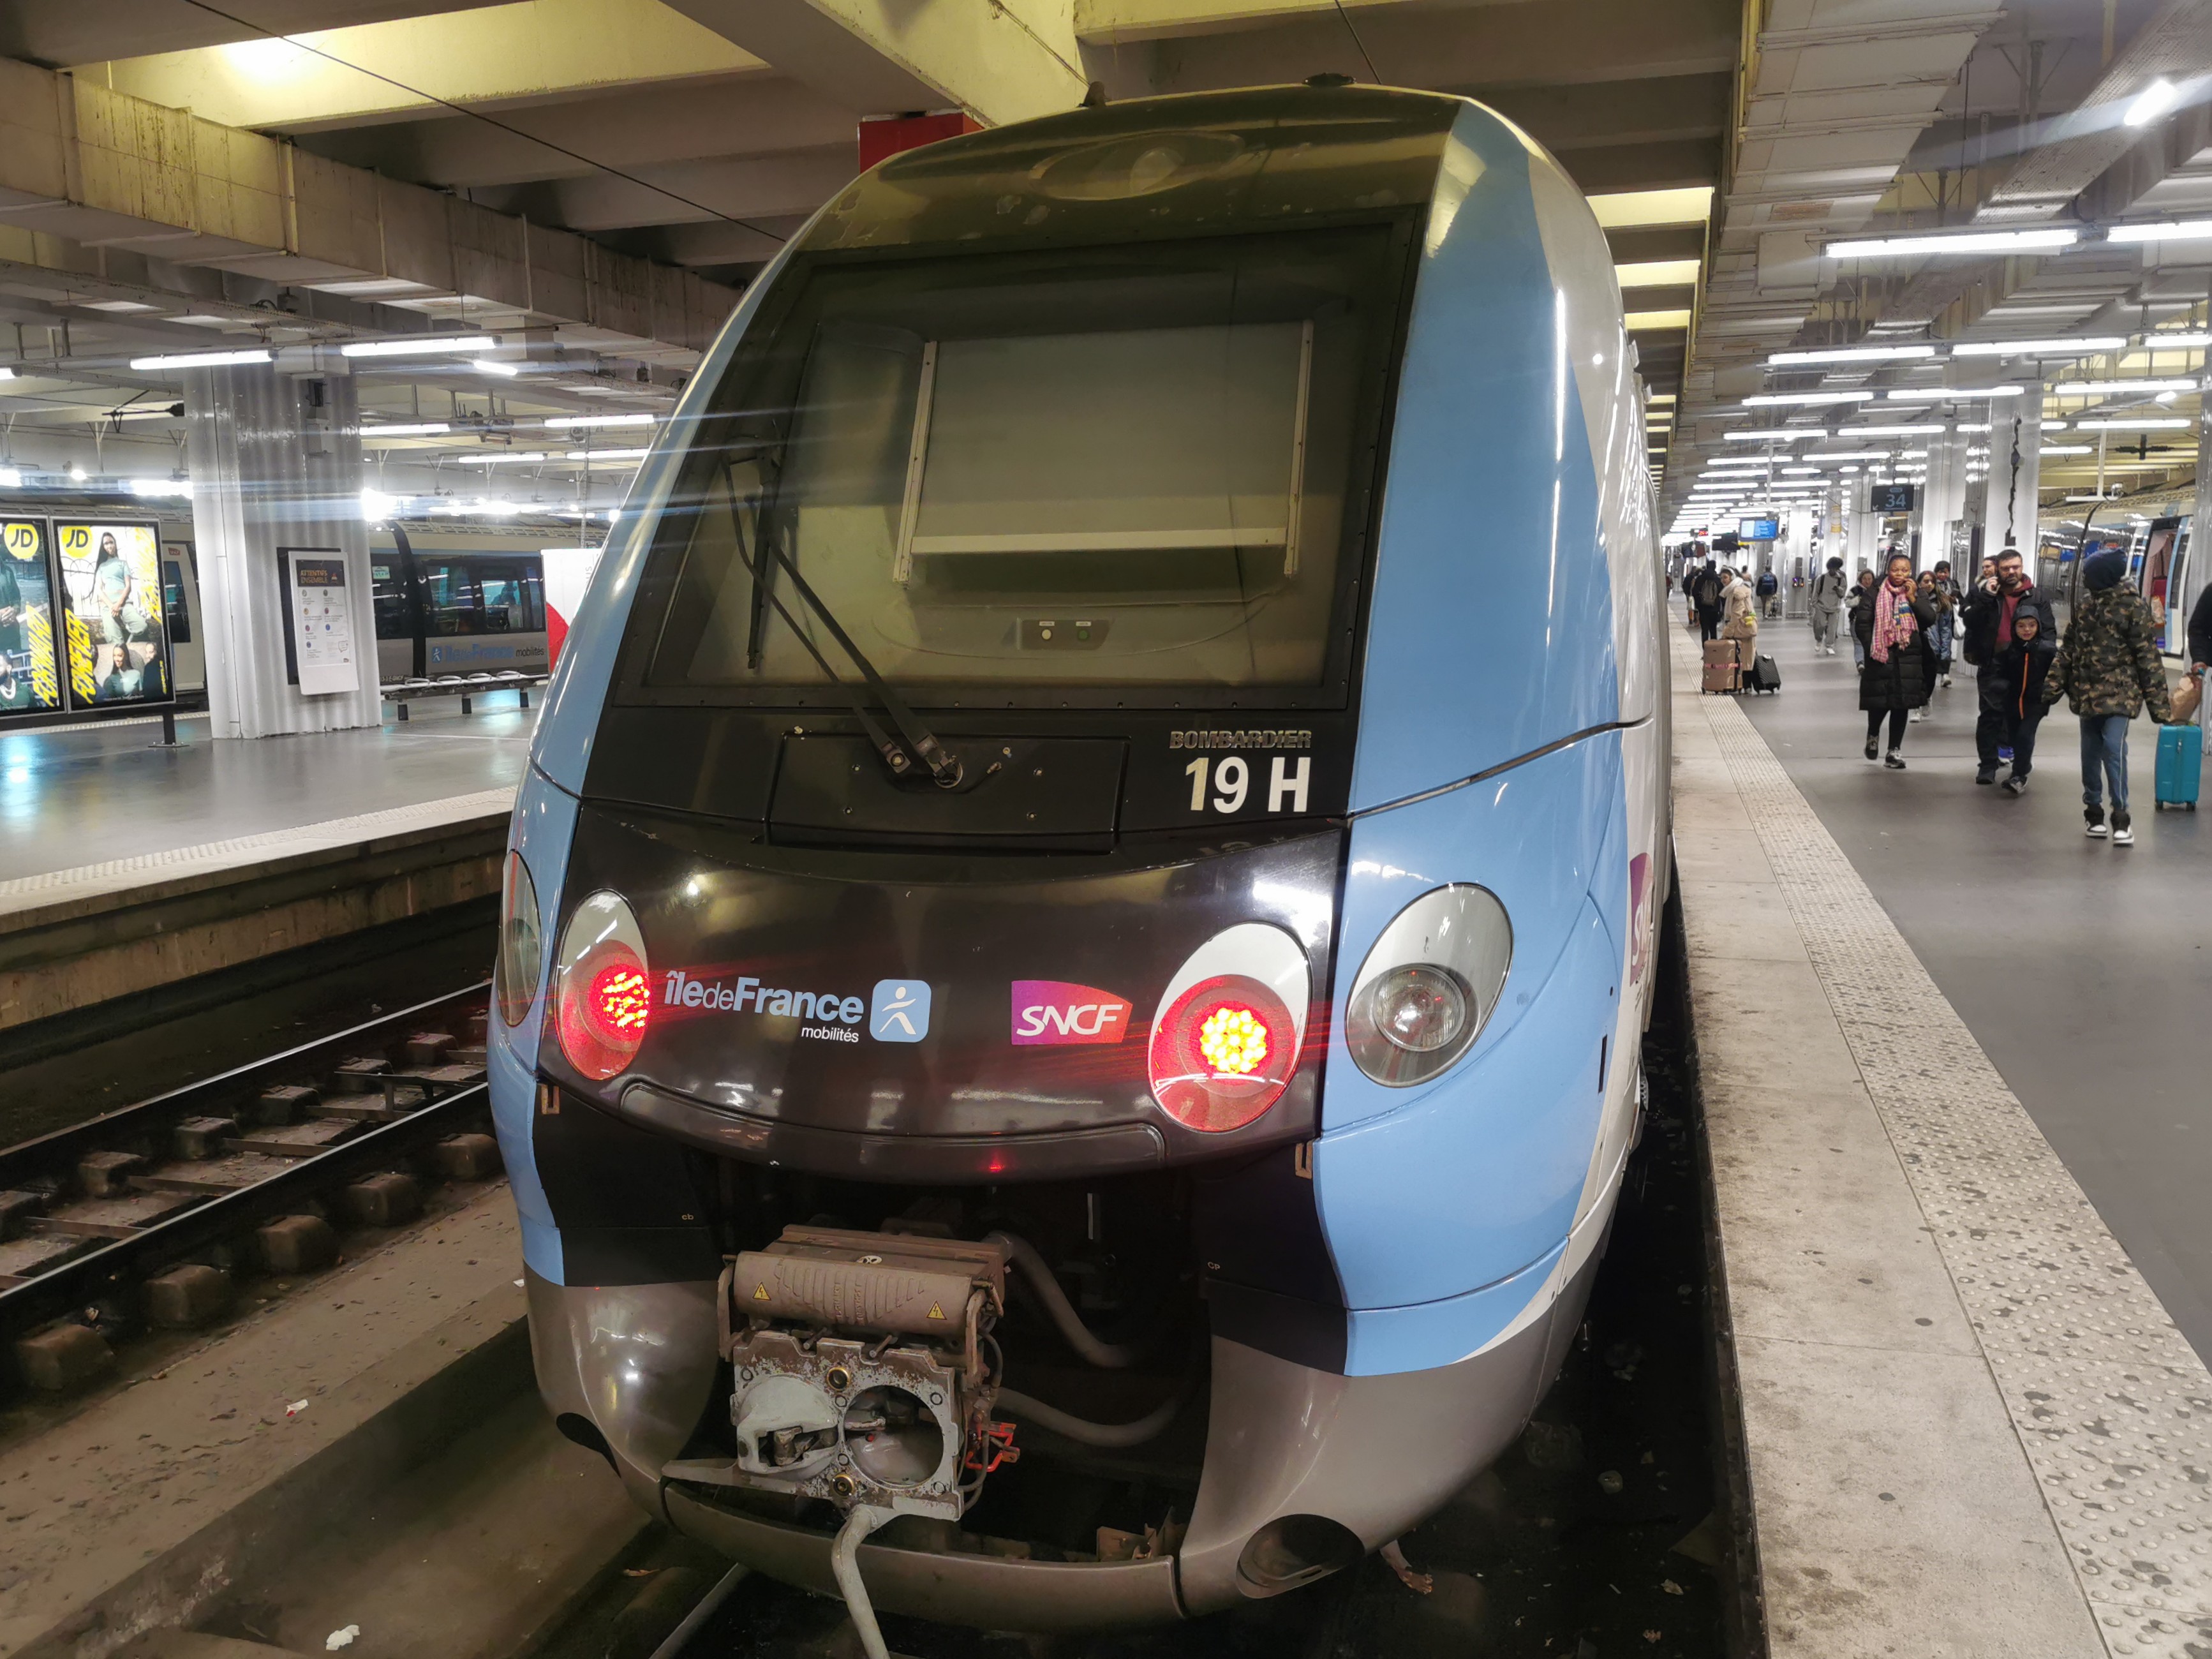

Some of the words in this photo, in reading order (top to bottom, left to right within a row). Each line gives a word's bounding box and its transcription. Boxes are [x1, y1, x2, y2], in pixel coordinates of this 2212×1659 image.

[1885, 494, 1906, 508] 34
[11, 529, 33, 547] JD
[66, 529, 88, 548] JD
[65, 608, 96, 704] FOREVER
[1169, 730, 1312, 749] BOMBARDIER
[1185, 756, 1249, 814] 19
[1268, 756, 1311, 812] H
[1016, 1004, 1123, 1036] SNCF
[801, 1023, 859, 1044] mobilités
